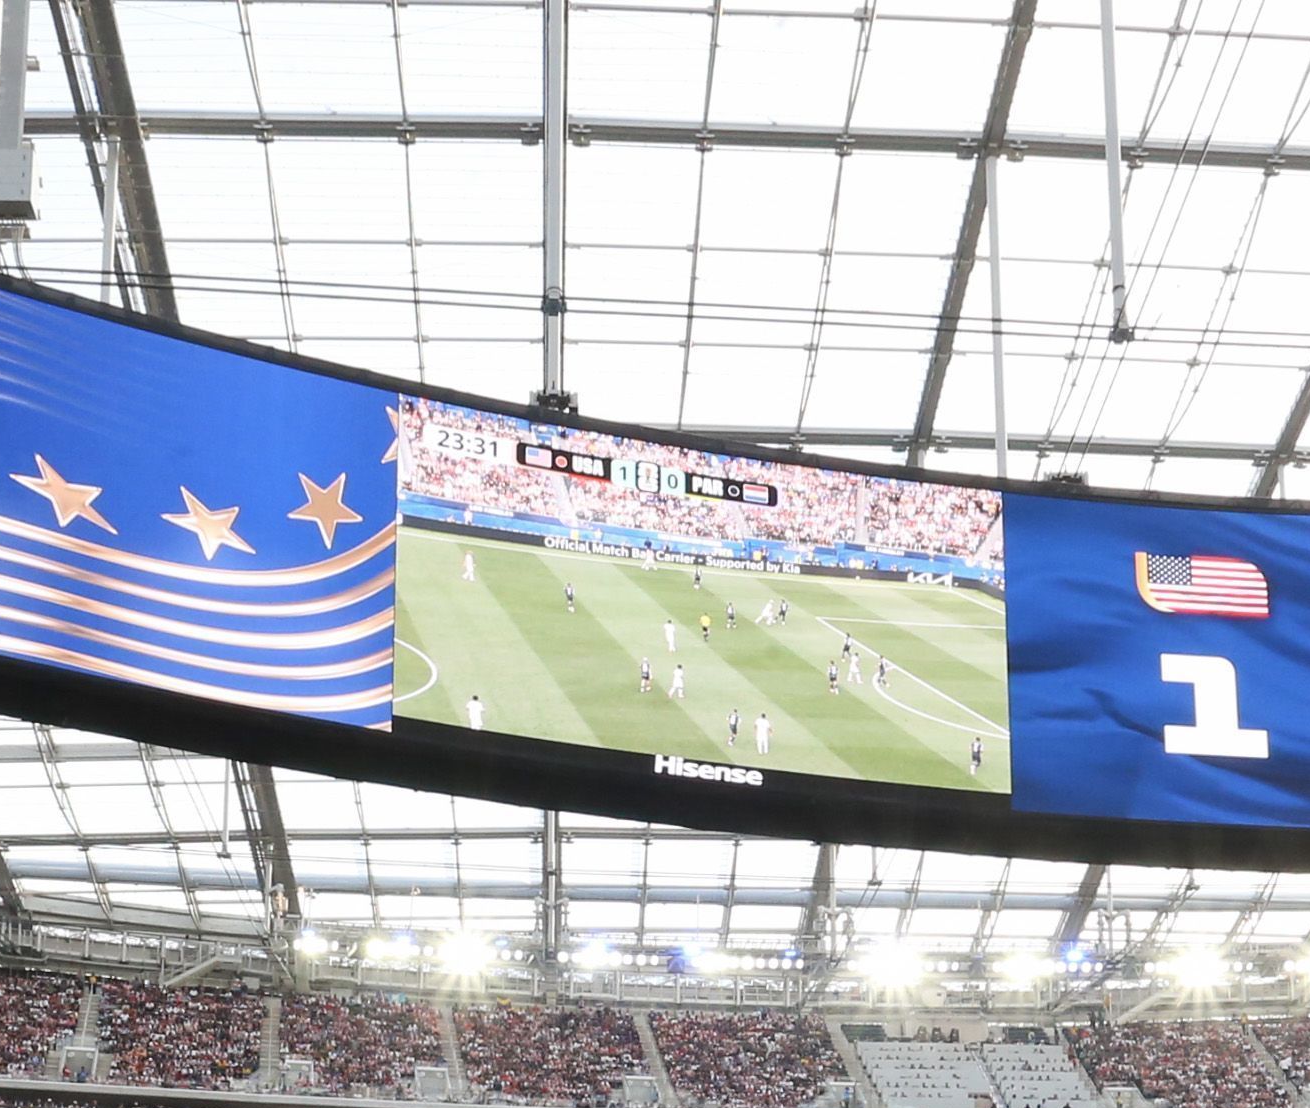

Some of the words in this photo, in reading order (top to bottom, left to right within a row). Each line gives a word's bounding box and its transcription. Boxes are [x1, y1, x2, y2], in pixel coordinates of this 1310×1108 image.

[437, 430, 498, 457] 23:31
[572, 454, 604, 477] USA
[620, 466, 628, 481] 1
[666, 474, 678, 490] 0
[692, 476, 723, 498] PAR
[544, 537, 589, 554] Official
[592, 541, 629, 558] Match
[655, 550, 695, 564] Carrier
[706, 555, 763, 571] Supported
[765, 559, 780, 574] by
[1160, 652, 1269, 759] 1
[654, 754, 764, 786] Hisense
